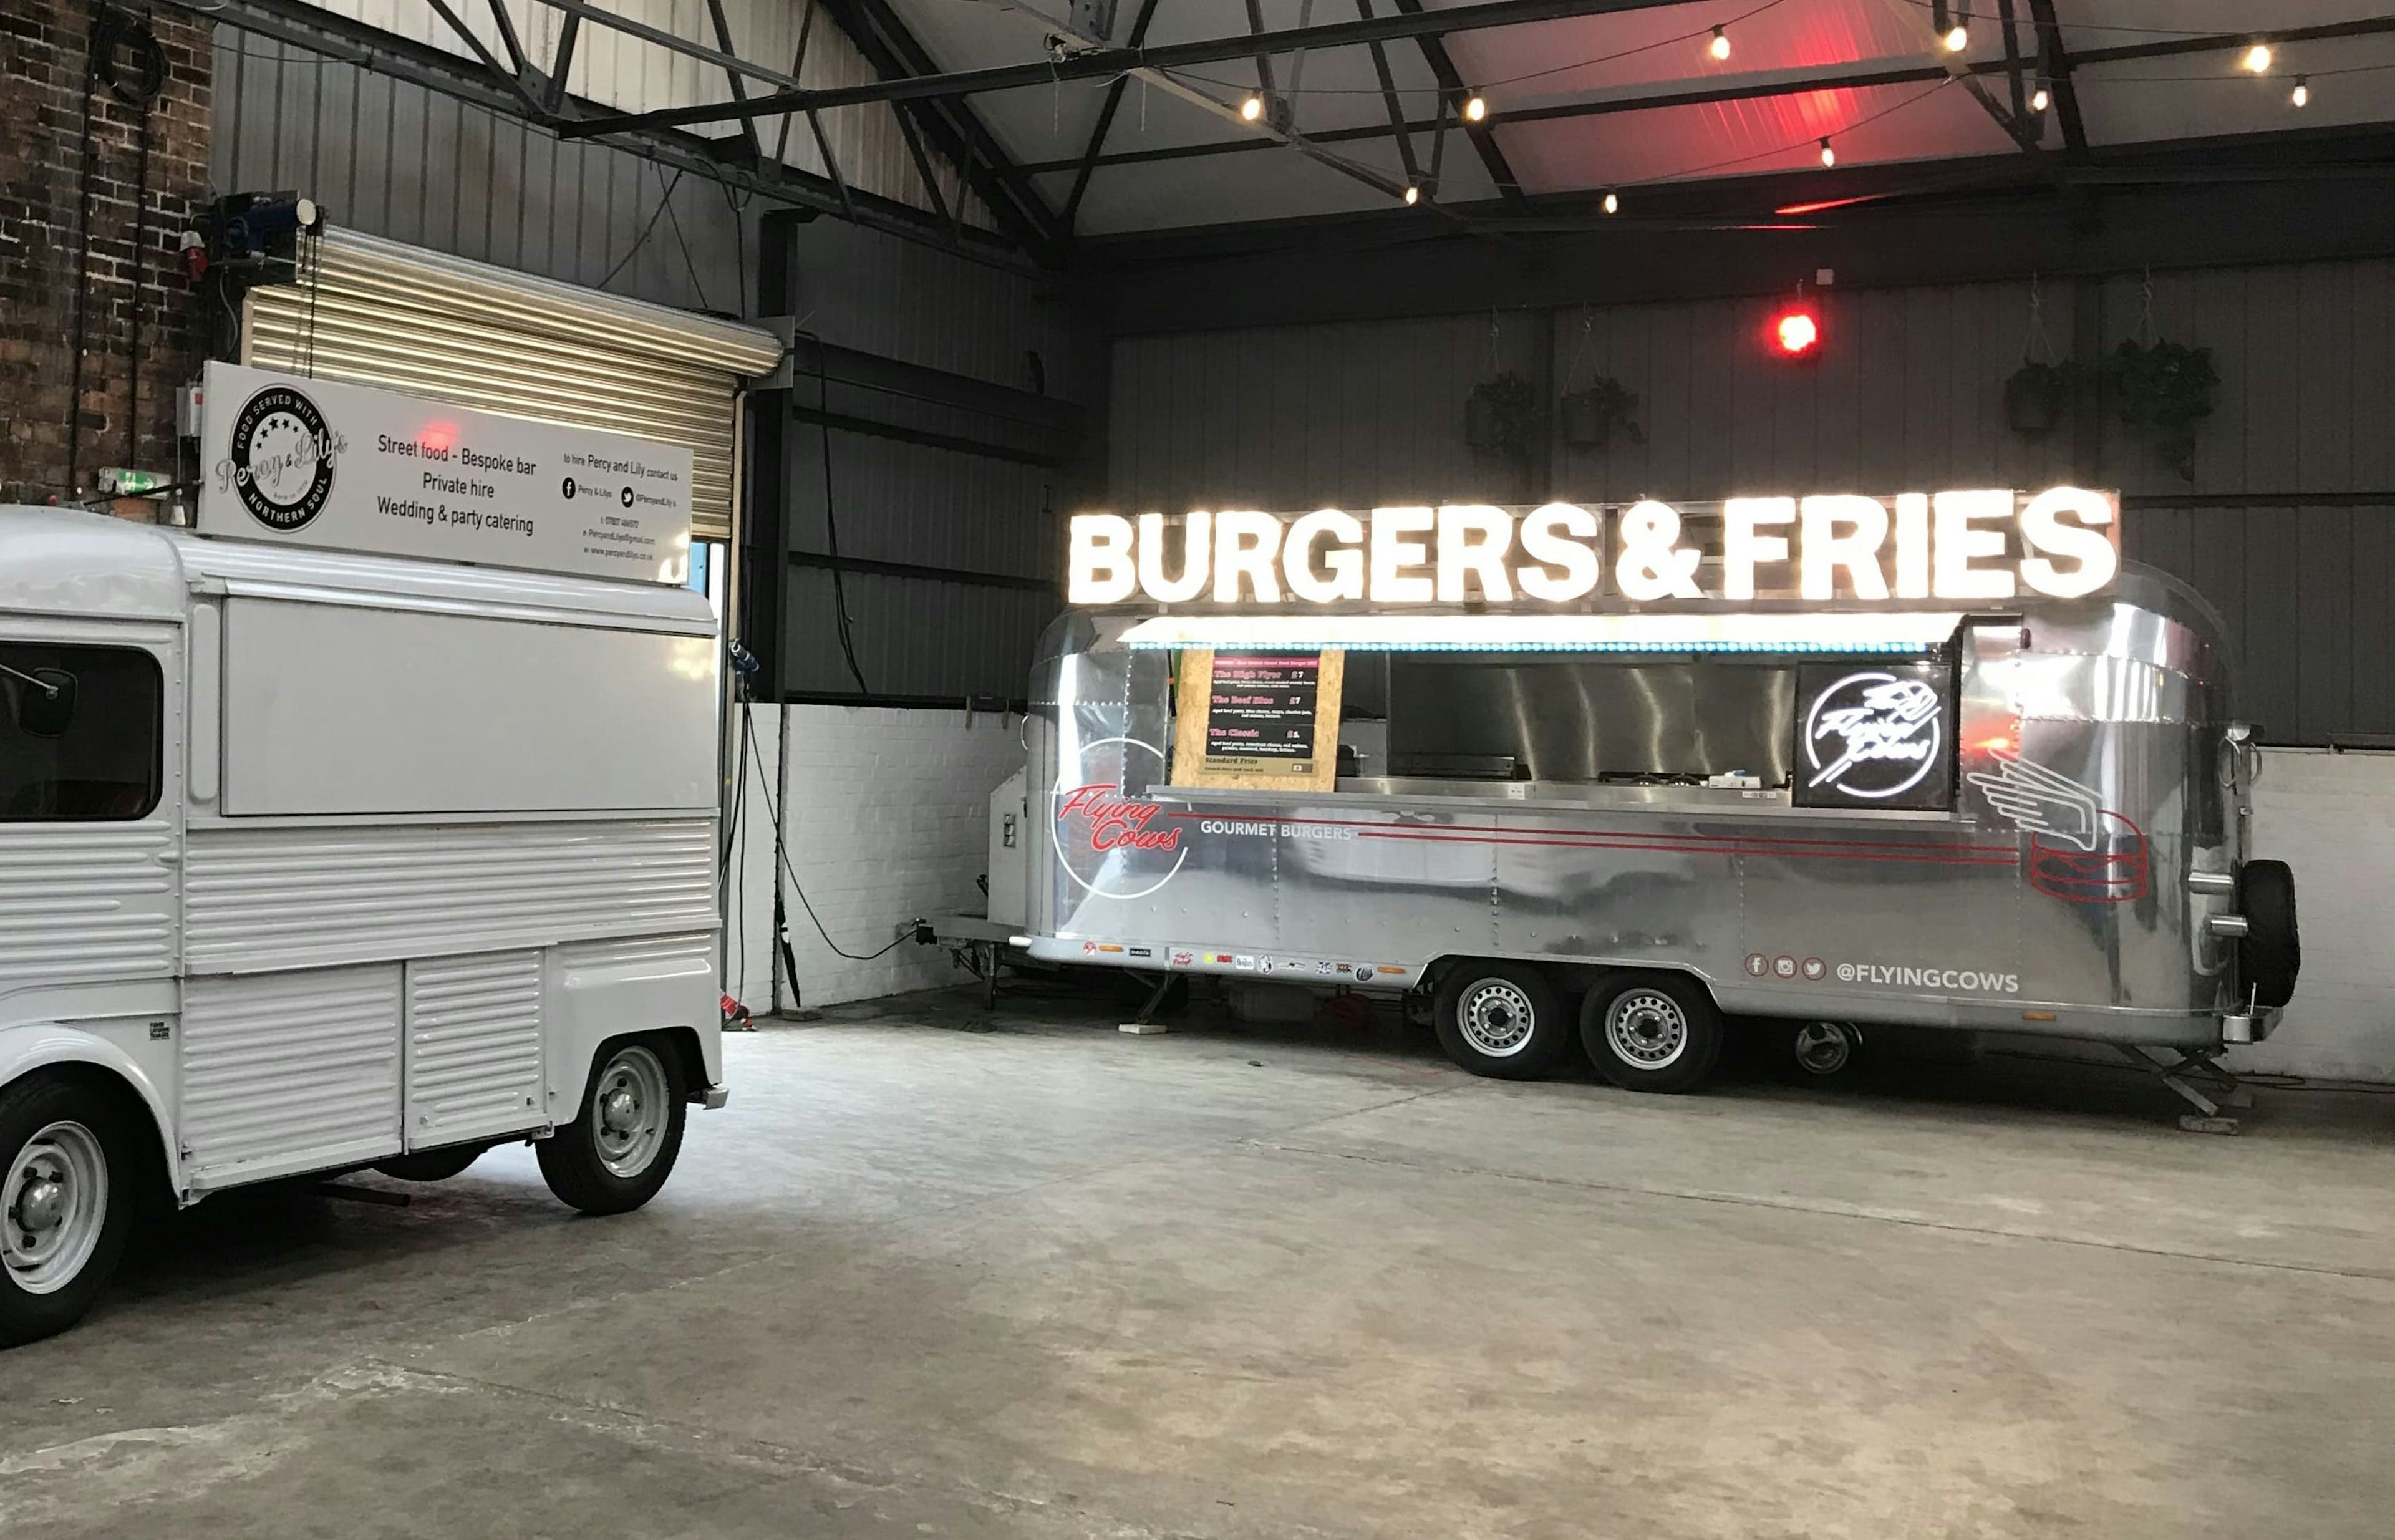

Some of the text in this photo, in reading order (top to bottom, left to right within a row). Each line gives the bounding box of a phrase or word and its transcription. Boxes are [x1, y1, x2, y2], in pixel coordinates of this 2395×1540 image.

[237, 394, 317, 449] FOOD SERVED WITH
[285, 453, 291, 467] &
[378, 434, 418, 457] Street
[422, 441, 448, 462] food
[462, 447, 514, 472] Bespoke
[517, 457, 536, 475] bar
[588, 454, 612, 473] Percy
[613, 461, 629, 473] and
[630, 462, 645, 478] Lily
[670, 473, 678, 481] us
[249, 493, 306, 523] NORTHERN
[307, 477, 327, 510] SOUL
[423, 472, 495, 498] Private hire
[377, 496, 534, 536] Wedding & party catering
[1068, 486, 2117, 604] BURGERS & FRIES
[1211, 695, 1229, 704] The
[1209, 728, 1226, 737] The
[1058, 783, 1163, 830] Flying
[1091, 819, 1183, 852] Cows
[1200, 820, 1353, 841] GOURMET BURGERS
[1836, 962, 2020, 993] @FLYINGCOWS
